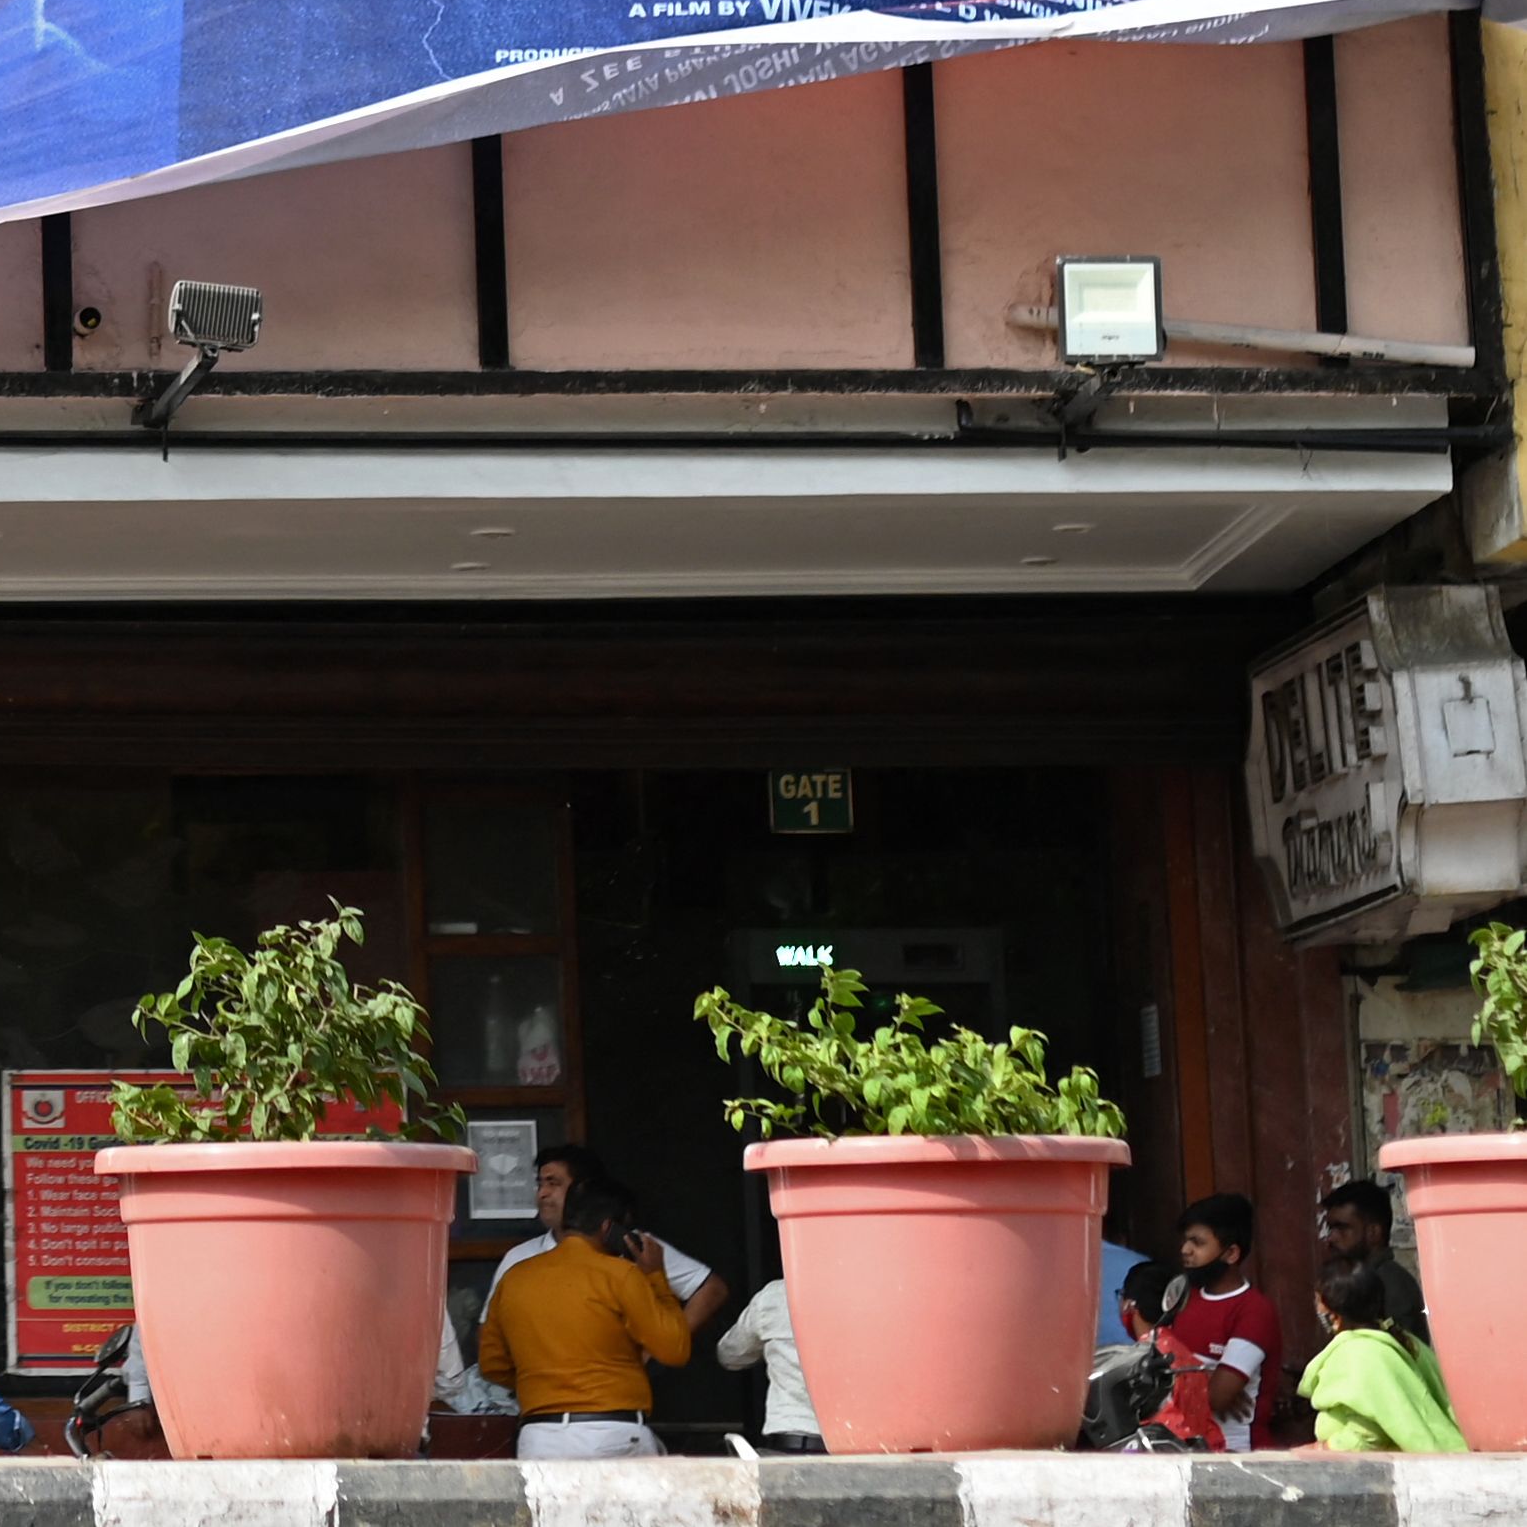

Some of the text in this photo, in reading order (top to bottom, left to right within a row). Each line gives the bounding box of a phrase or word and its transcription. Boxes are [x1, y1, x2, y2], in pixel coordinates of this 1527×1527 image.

[629, 2, 646, 18] A
[653, 1, 710, 18] FILM
[718, 0, 750, 17] BY
[779, 774, 842, 799] GATE
[803, 801, 820, 826] 1
[775, 945, 834, 967] WALK
[24, 1137, 60, 1150] Covid
[26, 1158, 44, 1168] We
[48, 1157, 76, 1168] need
[26, 1173, 65, 1184] Follow
[68, 1173, 100, 1184] these
[41, 1190, 69, 1200] Wear
[72, 1189, 97, 1200] face
[41, 1206, 90, 1217] Maintain
[41, 1223, 58, 1233] No
[61, 1223, 88, 1236] large
[41, 1239, 72, 1250] Don't
[75, 1239, 97, 1252] spit
[100, 1239, 111, 1250] in
[41, 1256, 73, 1266] Don't
